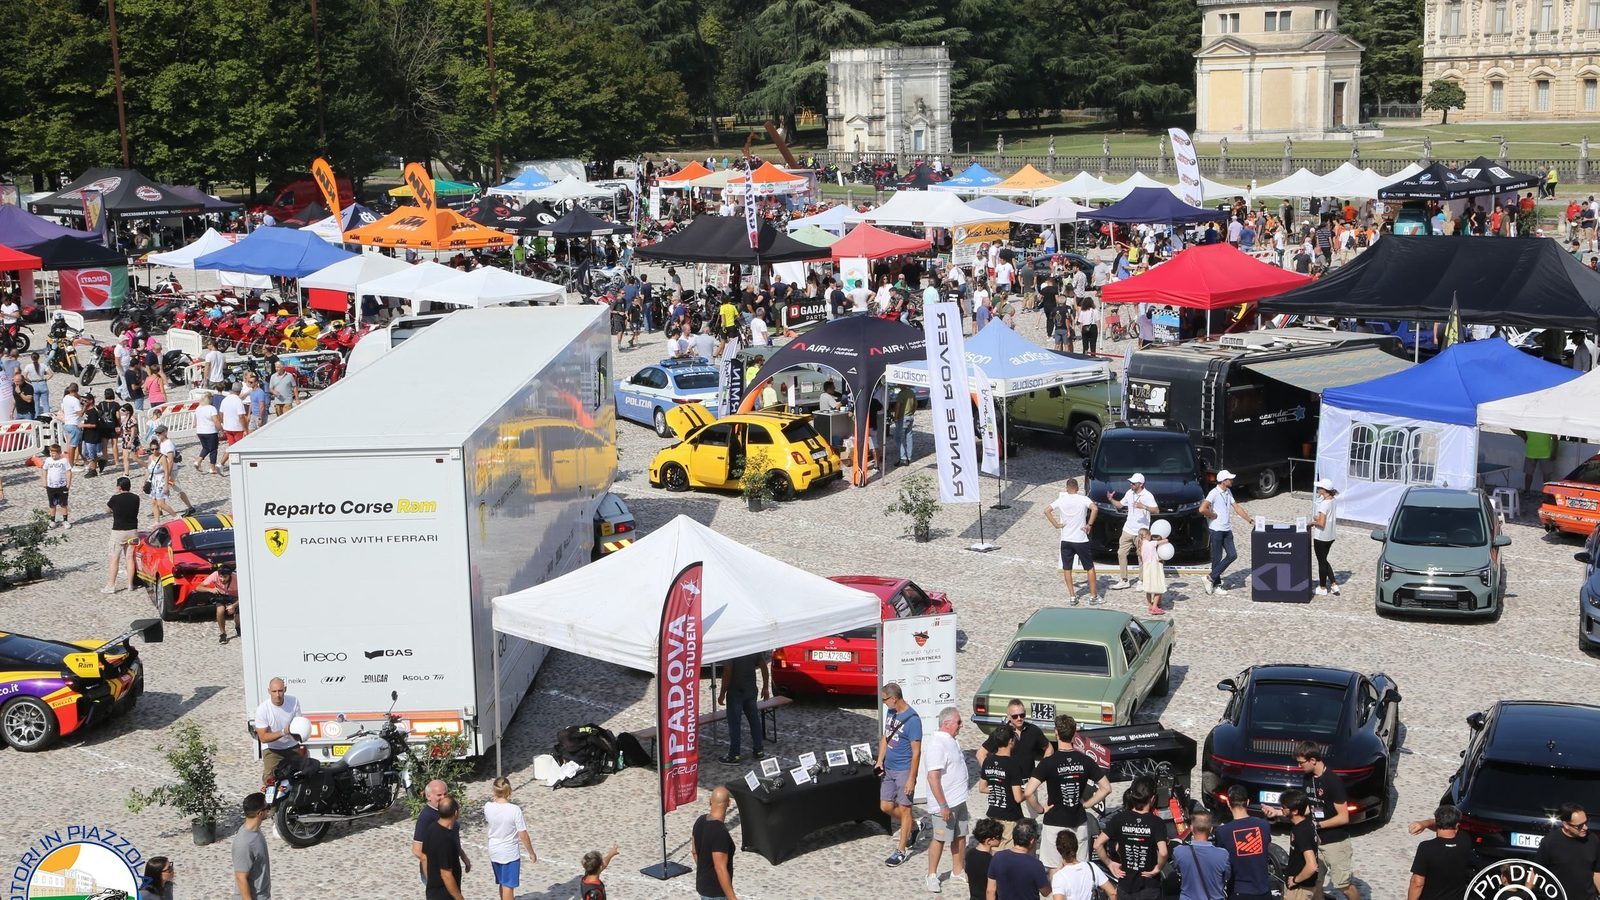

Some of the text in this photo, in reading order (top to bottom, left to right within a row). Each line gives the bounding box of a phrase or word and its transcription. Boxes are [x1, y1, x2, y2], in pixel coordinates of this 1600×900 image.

[1008, 351, 1058, 366] audison
[893, 369, 926, 383] audison
[1012, 378, 1044, 390] audison
[625, 396, 652, 409] POLIZIA
[264, 502, 336, 518] Reparto
[340, 500, 394, 514] Corse
[300, 534, 438, 545] RACING WITH FERRARI
[303, 650, 348, 662] ineco
[385, 648, 414, 657] GAS
[686, 614, 696, 751] FORMULA STUDENT
[1122, 826, 1151, 834] UNIPADOVA
[1518, 834, 1530, 846] GM
